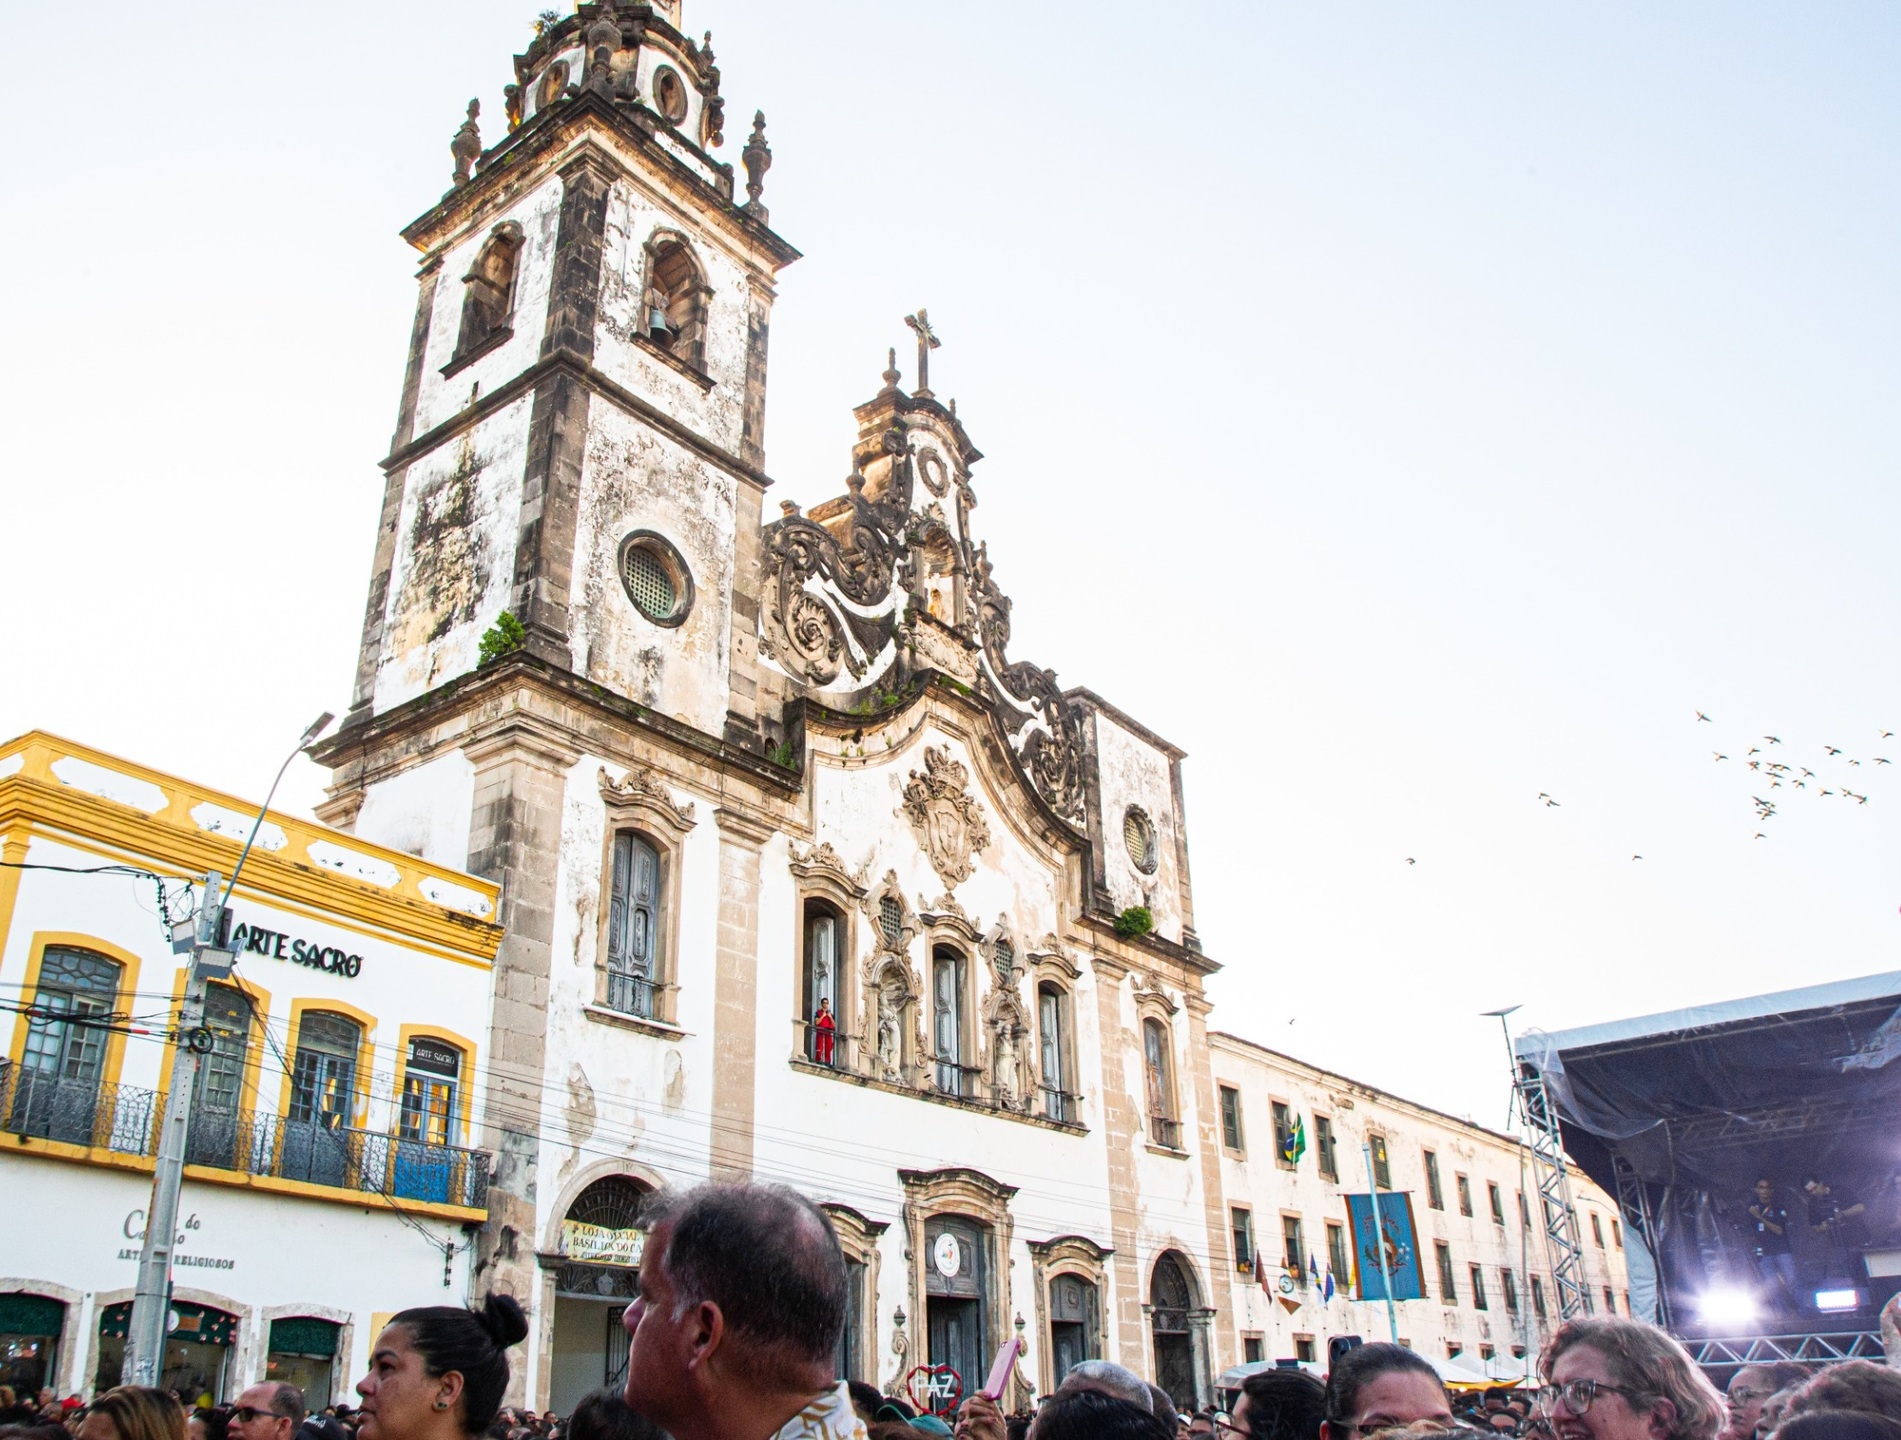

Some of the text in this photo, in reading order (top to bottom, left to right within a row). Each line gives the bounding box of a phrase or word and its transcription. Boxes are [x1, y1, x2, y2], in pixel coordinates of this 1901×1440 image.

[232, 922, 362, 978] ARTE SACRO
[173, 1254, 235, 1270] RELIGIOSOS
[914, 1374, 956, 1398] PAZ
